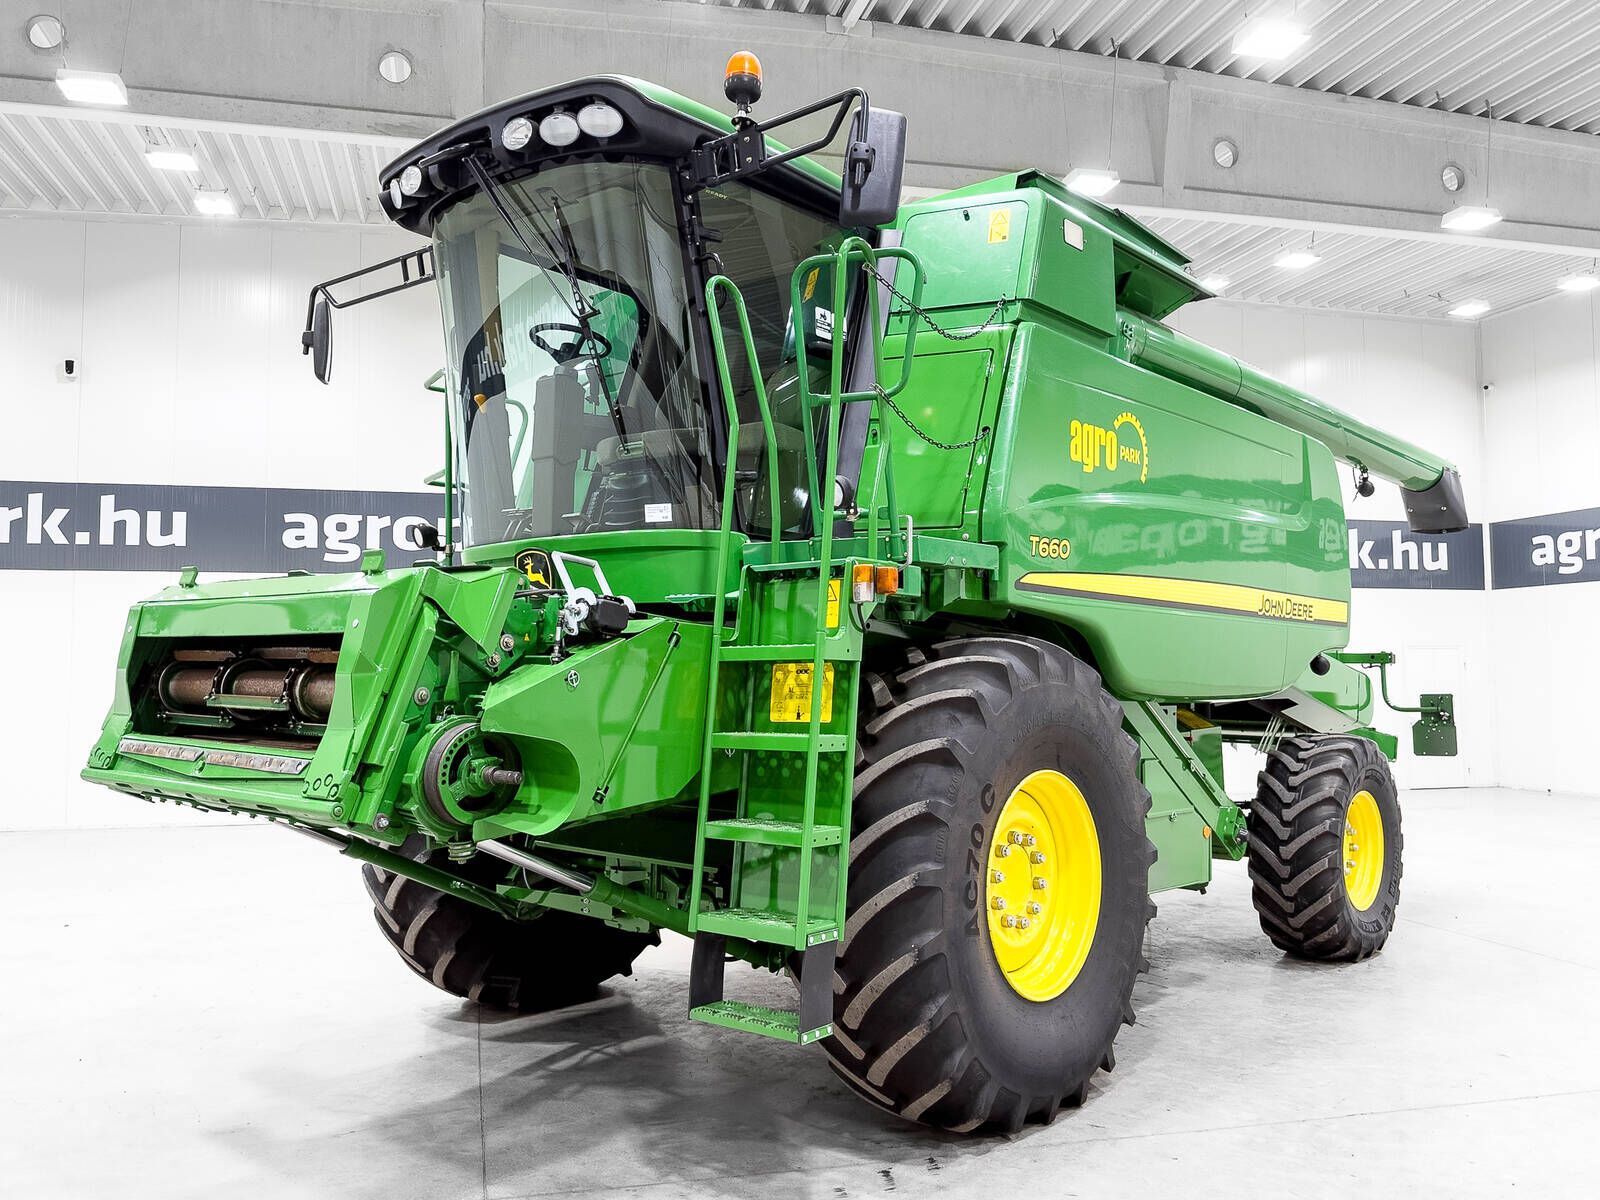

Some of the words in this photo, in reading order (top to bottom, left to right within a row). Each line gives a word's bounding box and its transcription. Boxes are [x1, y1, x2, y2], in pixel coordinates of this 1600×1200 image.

[1070, 419, 1118, 473] agro
[1119, 445, 1141, 465] PARK
[0, 492, 187, 547] rk.hu
[1029, 535, 1071, 560] T660
[1348, 528, 1449, 571] k.hu
[1531, 528, 1600, 575] agr
